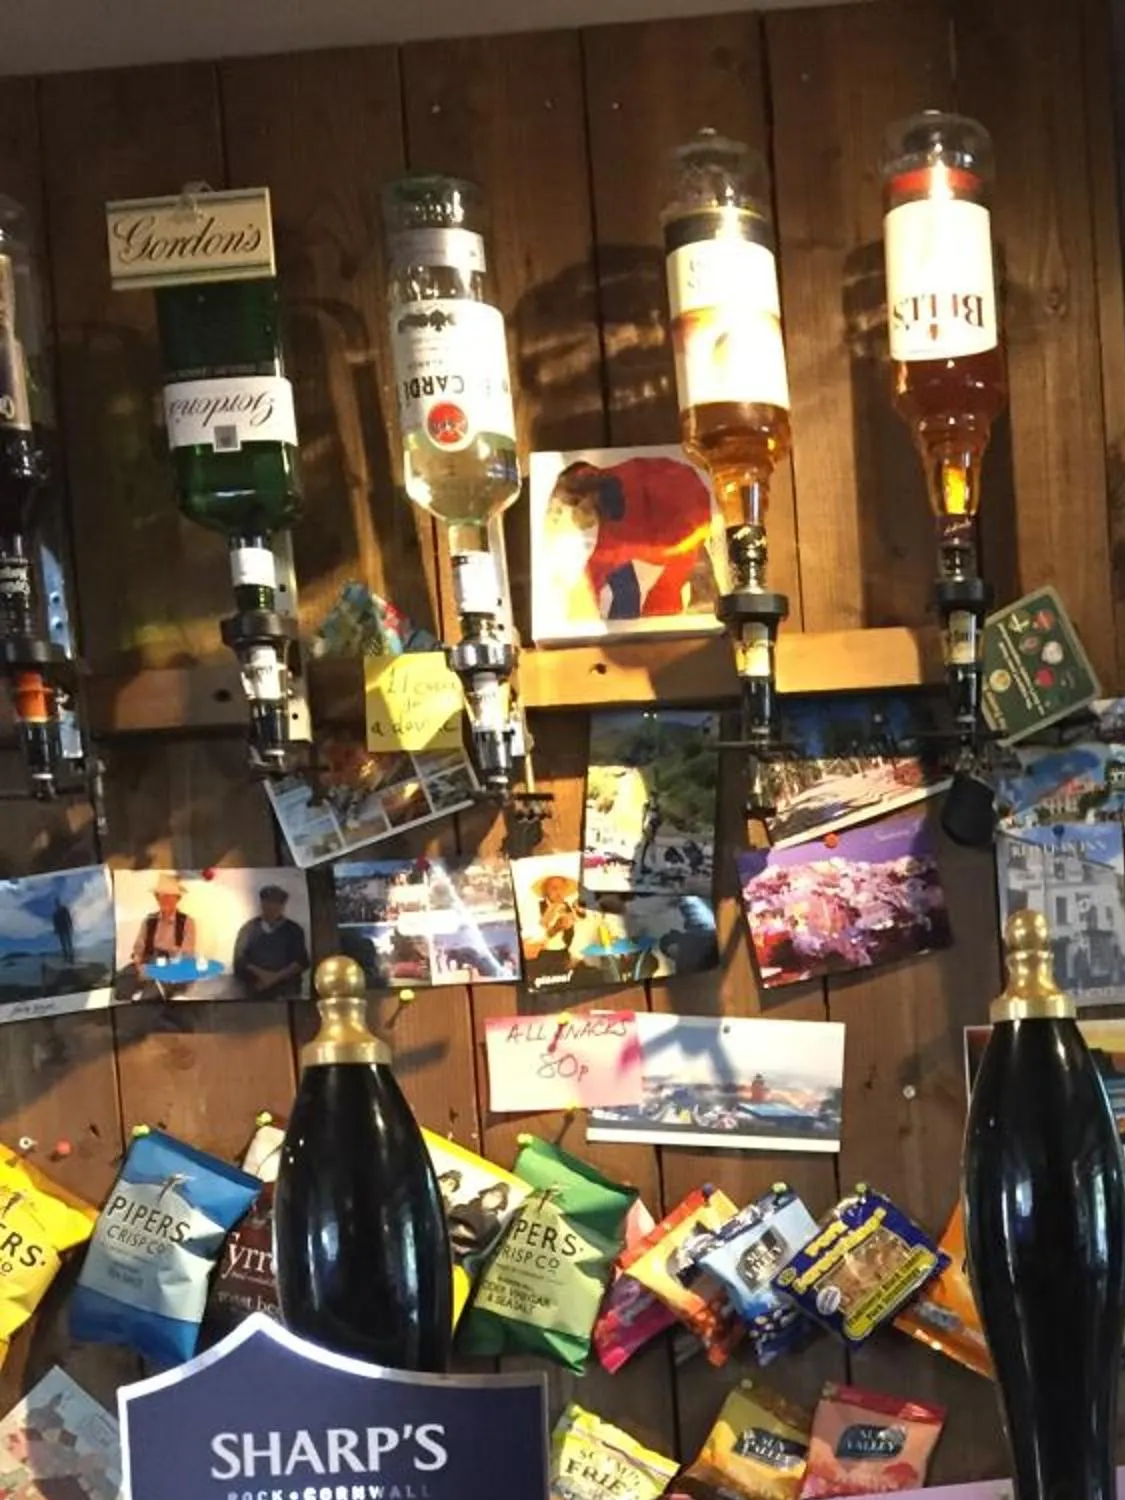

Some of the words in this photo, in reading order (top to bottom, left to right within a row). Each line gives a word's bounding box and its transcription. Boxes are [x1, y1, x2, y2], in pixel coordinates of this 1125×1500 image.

[113, 215, 262, 264] Gordon's
[506, 1022, 548, 1043] ALL
[536, 1053, 590, 1083] 80p
[210, 1423, 449, 1481] SHARP'S
